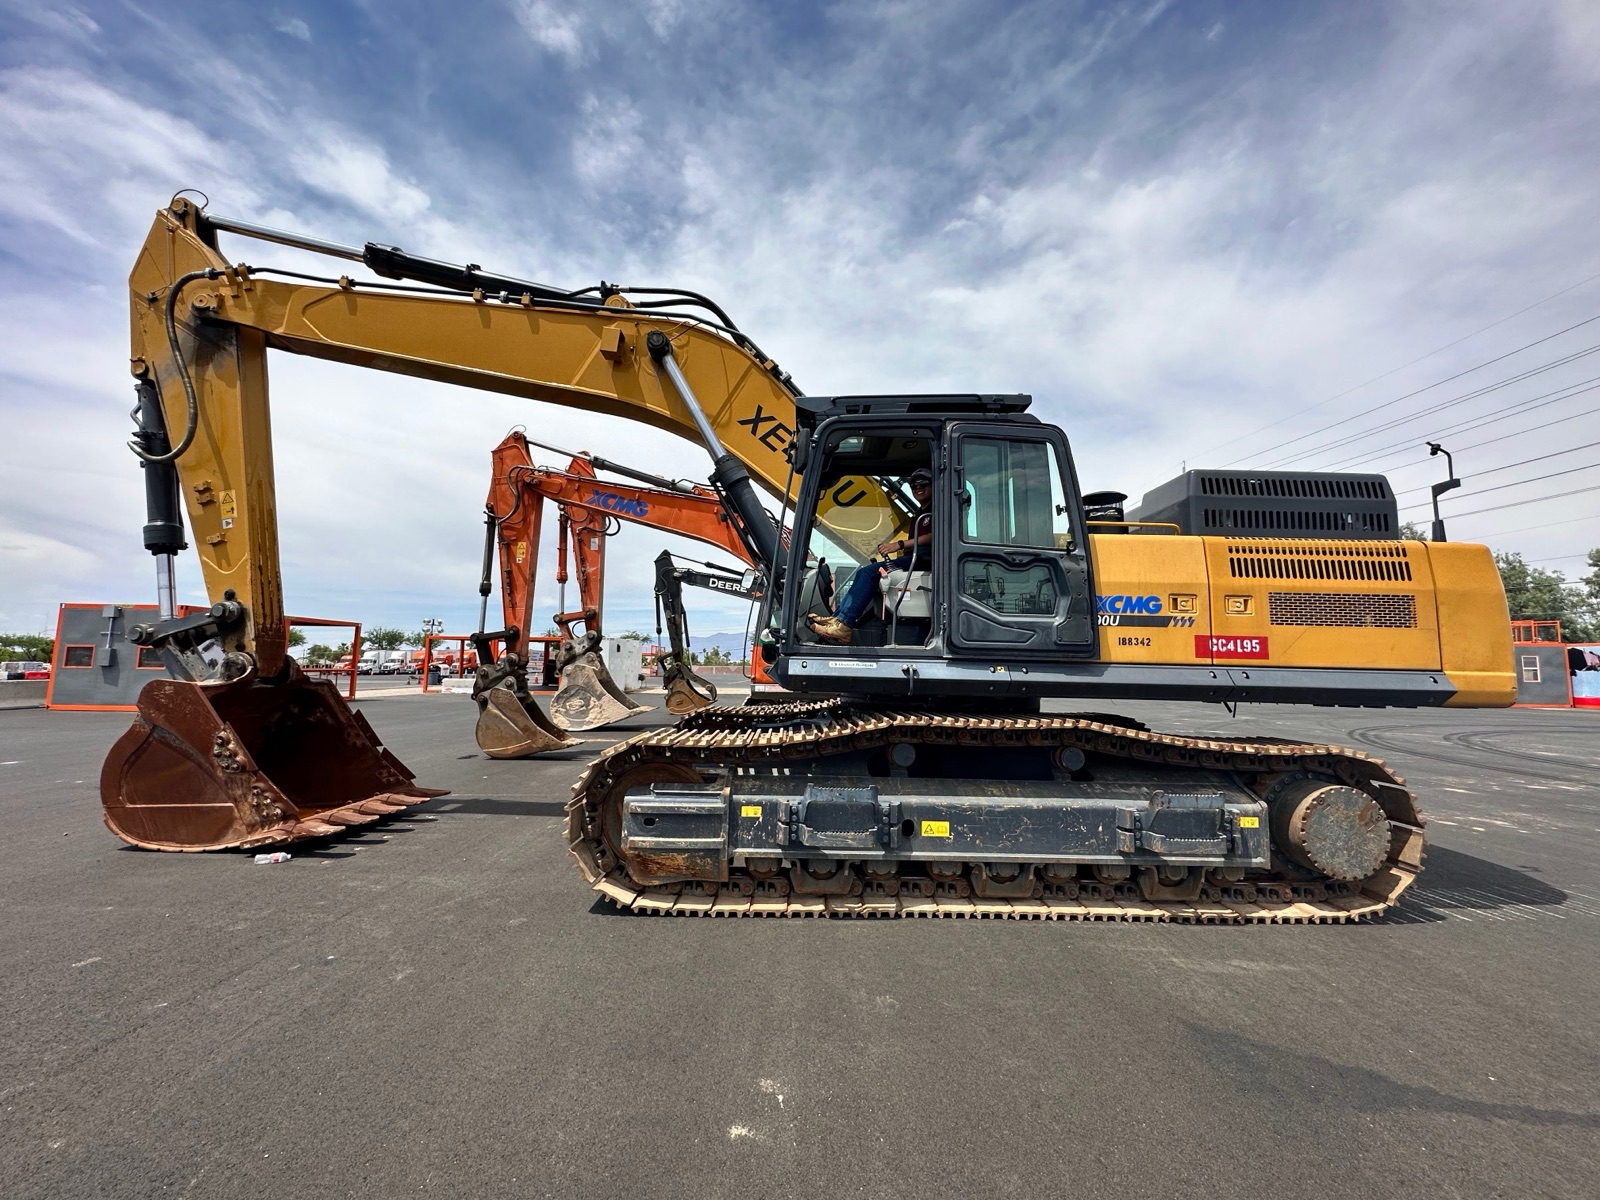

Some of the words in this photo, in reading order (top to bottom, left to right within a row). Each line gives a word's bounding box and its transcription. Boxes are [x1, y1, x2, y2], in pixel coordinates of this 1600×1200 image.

[586, 489, 649, 517] XCMG
[1096, 595, 1162, 614] XCMG
[1118, 637, 1151, 646] 188342
